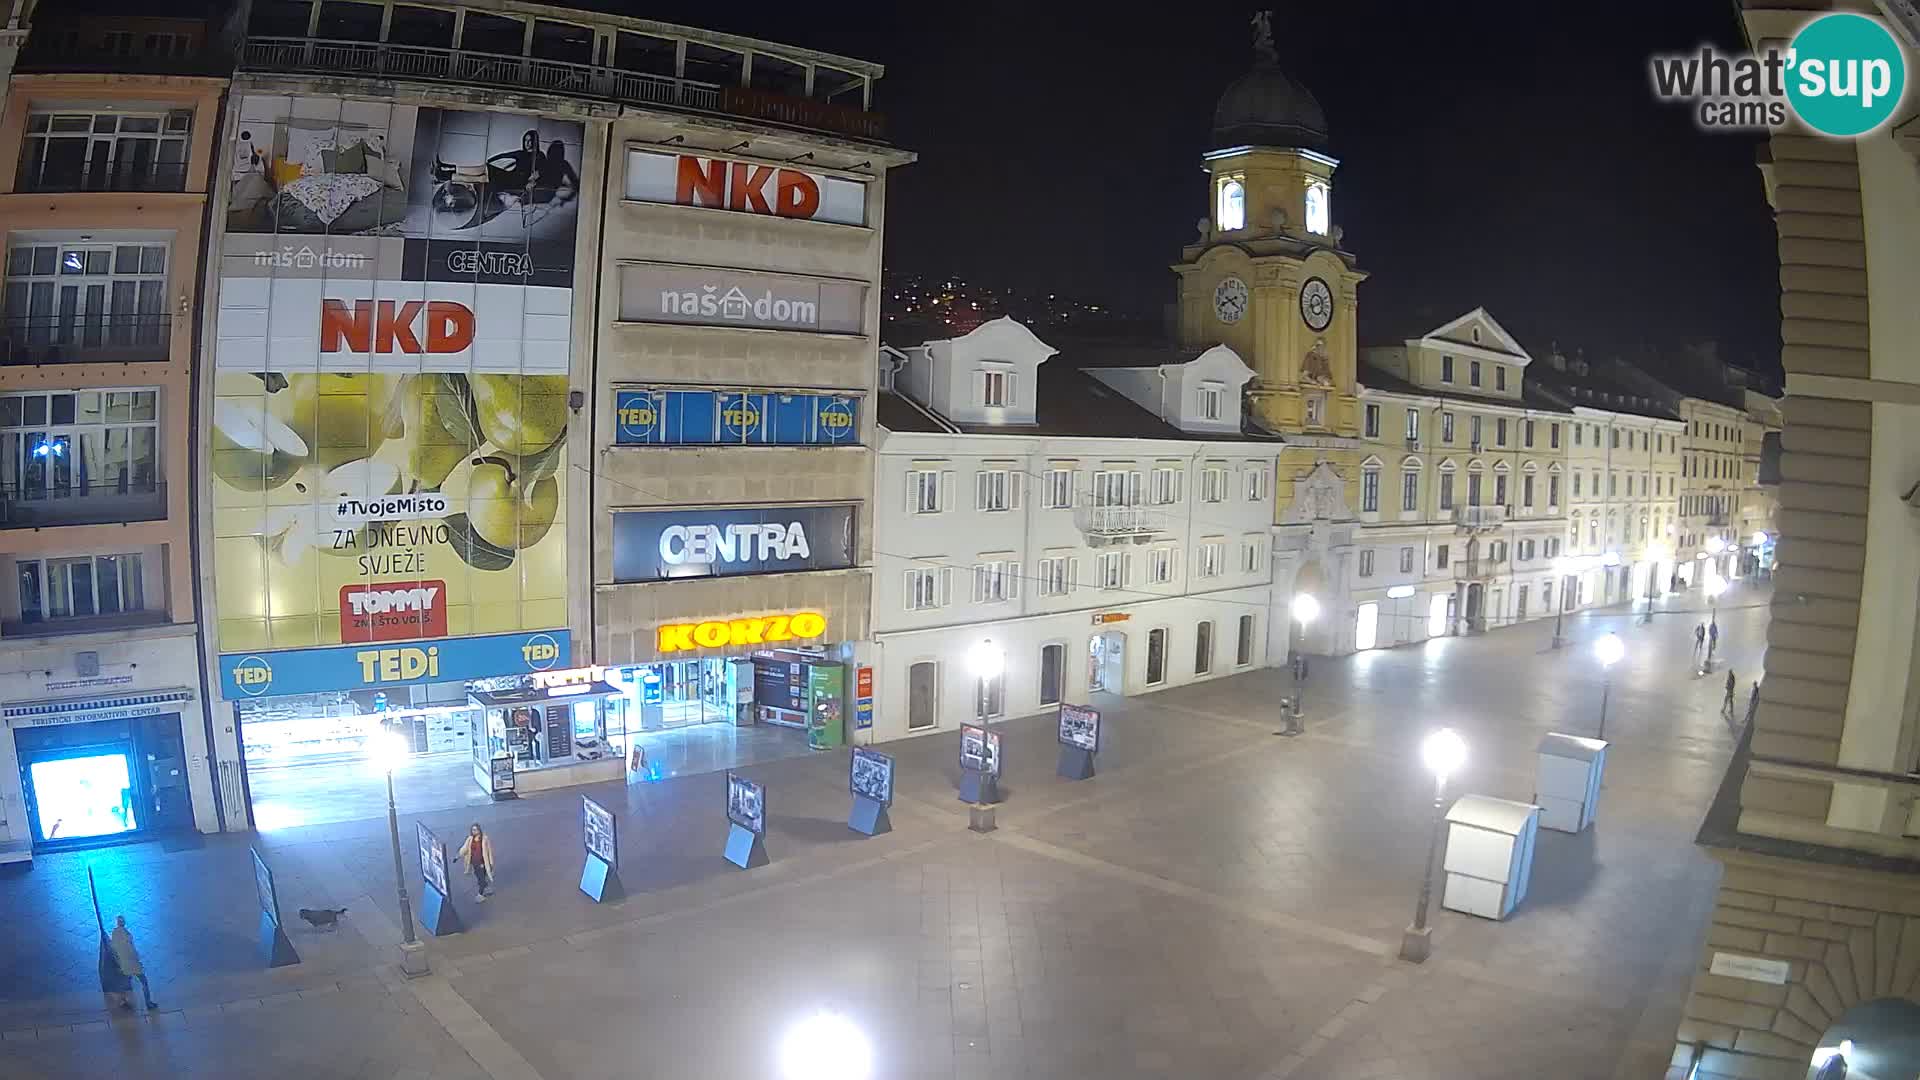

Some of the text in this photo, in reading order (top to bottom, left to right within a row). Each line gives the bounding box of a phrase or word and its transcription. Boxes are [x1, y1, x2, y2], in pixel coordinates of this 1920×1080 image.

[676, 154, 820, 220] NKD
[254, 246, 364, 269] naš dom
[448, 250, 533, 276] CENTRA
[661, 284, 815, 324] naš dom
[320, 298, 476, 354] NKD
[618, 408, 657, 426] TEDi
[723, 410, 759, 426] TEDi
[820, 412, 853, 427] TEDi
[337, 497, 445, 517] #TvojeMisto
[333, 524, 450, 550] ZA DNEVNO
[659, 521, 810, 565] CENTRA
[358, 548, 425, 576] SVJEŽE
[348, 588, 438, 615] TOMMY
[658, 612, 825, 652] KORZO
[357, 646, 440, 683] TEDi
[522, 643, 560, 662] TEDi
[233, 666, 272, 685] TEDi
